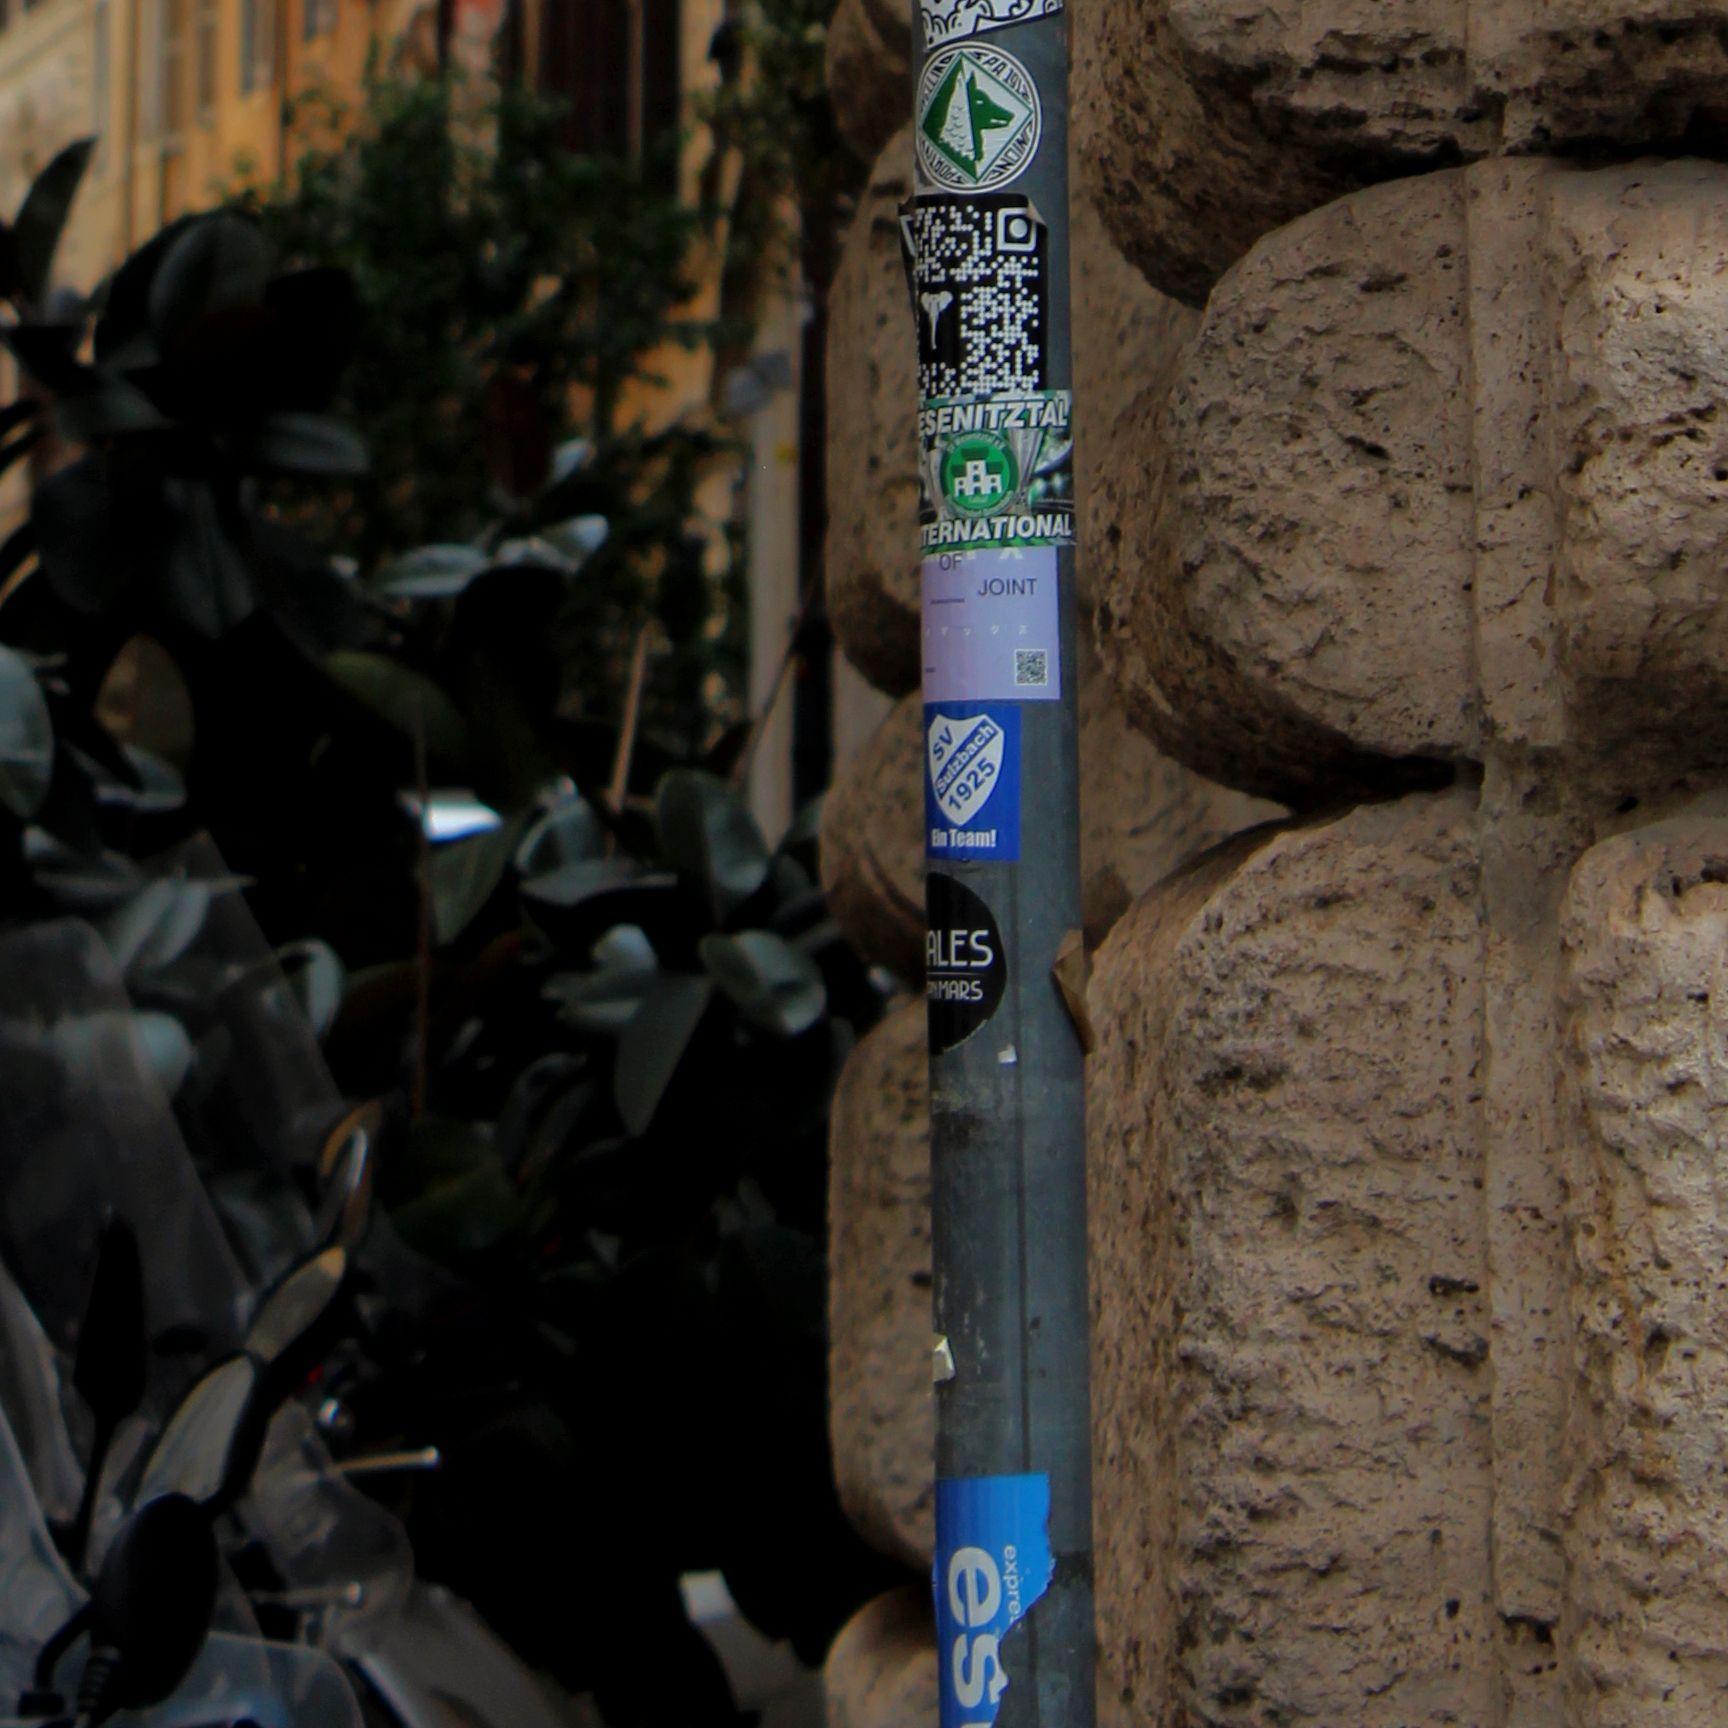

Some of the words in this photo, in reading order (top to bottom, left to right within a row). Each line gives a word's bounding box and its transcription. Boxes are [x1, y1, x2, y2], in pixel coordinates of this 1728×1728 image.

[939, 553, 962, 571] OF
[978, 578, 1037, 596] JOINT
[933, 726, 955, 761] SV
[937, 722, 995, 796] Sulzbach
[949, 760, 996, 813] 1925
[932, 829, 948, 848] Ein
[949, 828, 997, 848] Team!
[939, 980, 984, 1000] MARS
